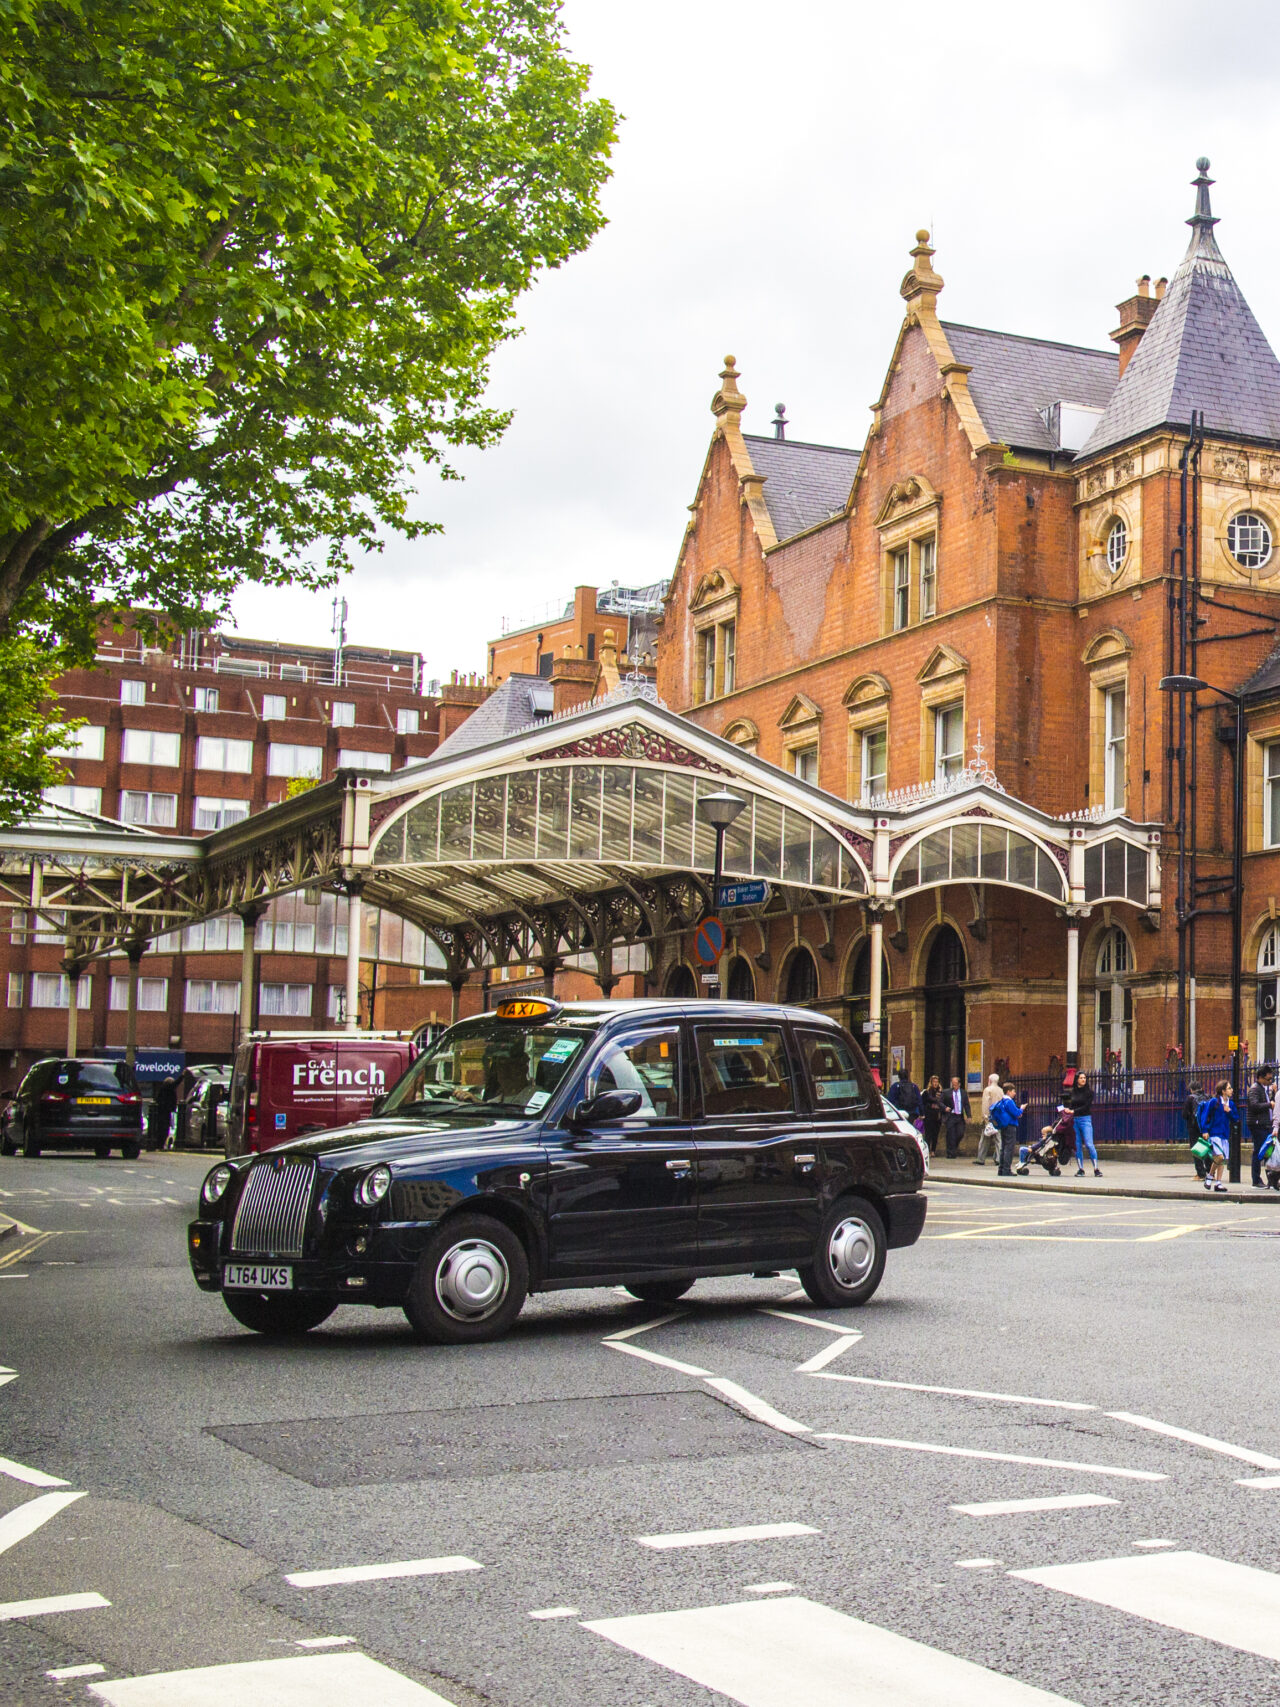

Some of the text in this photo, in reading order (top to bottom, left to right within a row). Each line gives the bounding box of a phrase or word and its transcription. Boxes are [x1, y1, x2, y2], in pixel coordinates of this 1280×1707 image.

[502, 1003, 535, 1016] TAXI
[135, 1062, 181, 1074] ravelodge
[293, 1062, 385, 1085] French
[228, 1266, 288, 1286] LT64 UKS
